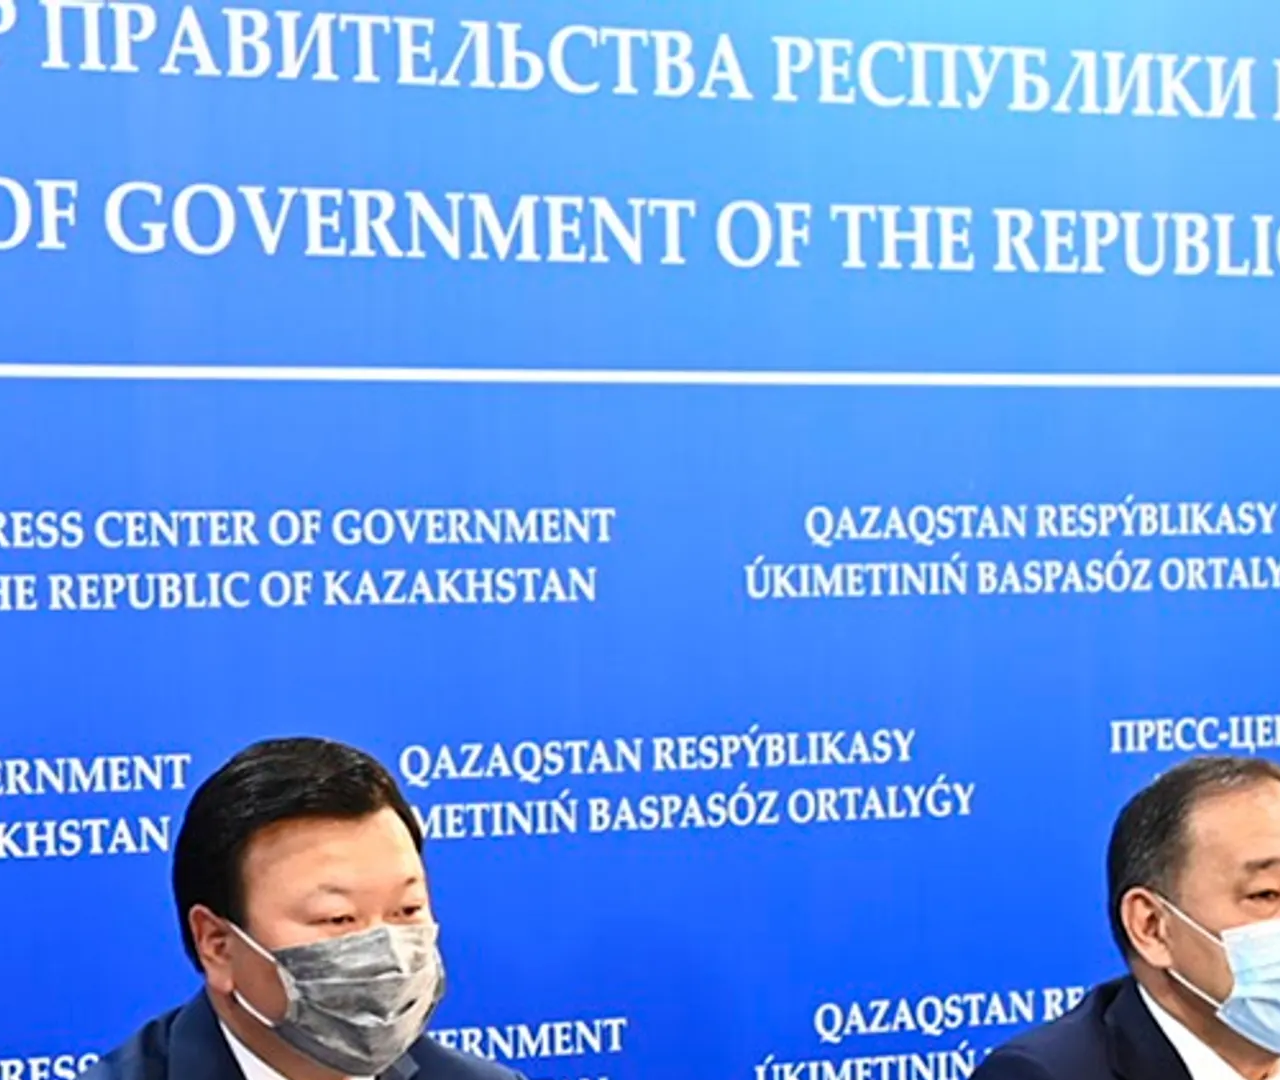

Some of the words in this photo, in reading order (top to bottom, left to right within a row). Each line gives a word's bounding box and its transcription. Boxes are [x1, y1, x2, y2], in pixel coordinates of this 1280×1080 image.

[39, 0, 754, 101] ПРАВИТЕЛЬСТВА
[773, 37, 1255, 118] РЕСПУБЛИКИ
[105, 182, 696, 264] GOVERNMENT
[717, 200, 811, 267] OF
[831, 205, 974, 270] THE
[95, 510, 260, 548] CENTER
[269, 509, 321, 546] OF
[332, 508, 616, 545] GOVERNMENT
[806, 505, 1027, 548] QAZAQSTAN
[1037, 495, 1276, 537] RESPÝBLIKASY
[48, 572, 250, 610] REPUBLIC
[260, 571, 312, 607] OF
[323, 568, 596, 605] KAZAKHSTAN
[745, 553, 968, 599] ÚKIMETINIŃ
[977, 549, 1152, 594] BASPASÓZ
[399, 738, 643, 788] QAZAQSTAN
[653, 724, 914, 771] RESPÝBLIKASY
[588, 782, 780, 832] BASPASÓZ
[788, 774, 974, 824] ORTALYǴY
[814, 989, 1035, 1044] QAZAQSTAN
